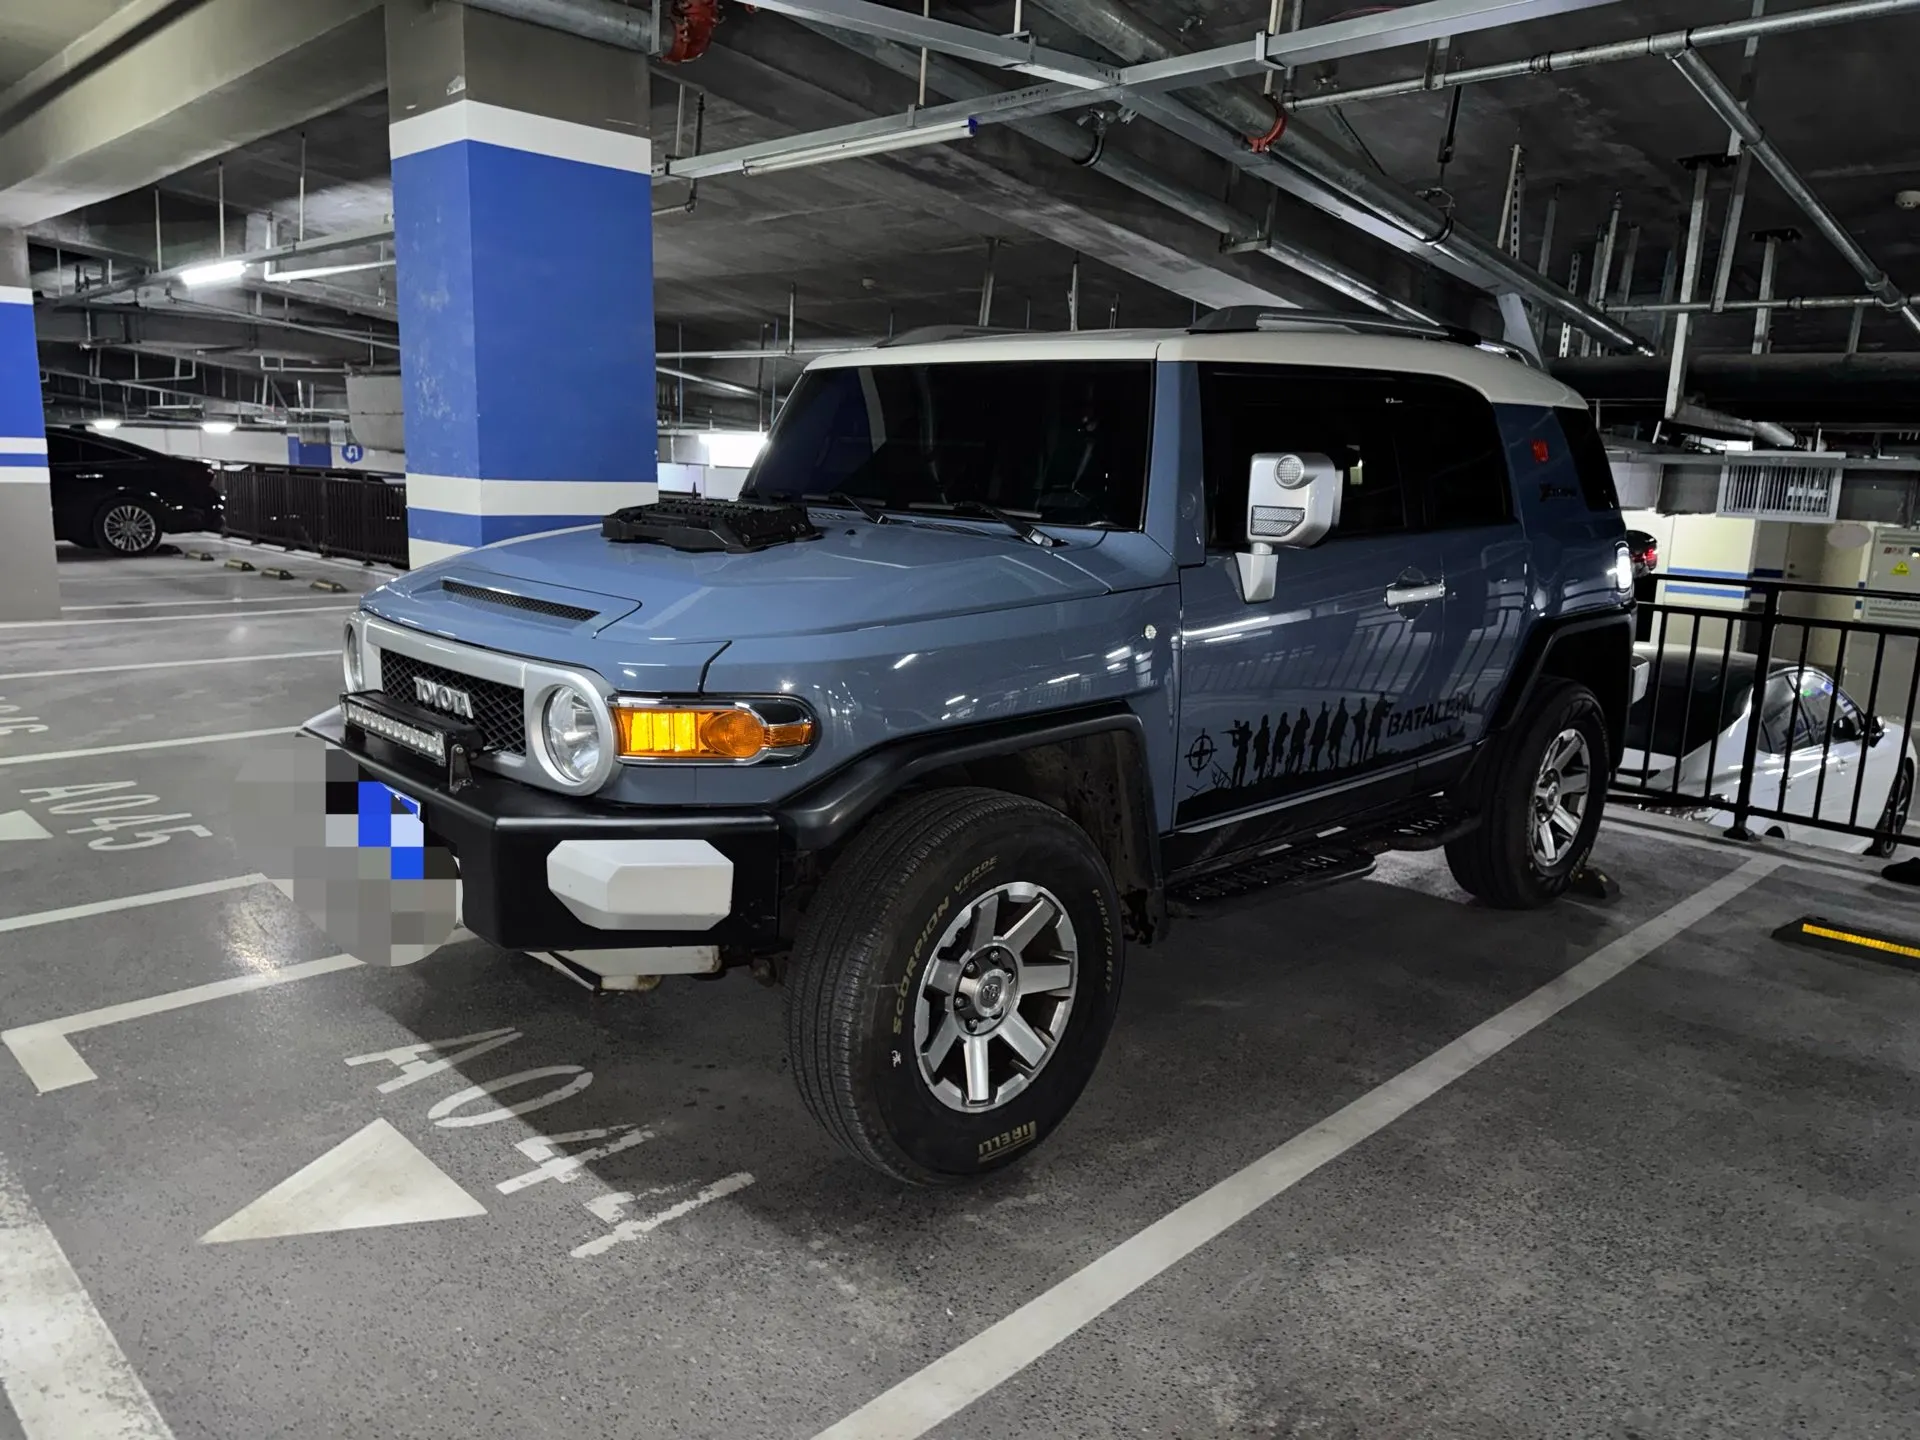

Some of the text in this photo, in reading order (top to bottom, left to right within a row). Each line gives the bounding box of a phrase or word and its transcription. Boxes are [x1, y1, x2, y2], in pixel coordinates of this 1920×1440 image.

[413, 676, 474, 719] TOYOTA
[20, 780, 213, 850] A045
[893, 896, 950, 1035] SCORPION
[954, 855, 998, 892] VERDE
[344, 1027, 756, 1258] A044
[977, 1119, 1037, 1163] PIRELLI
